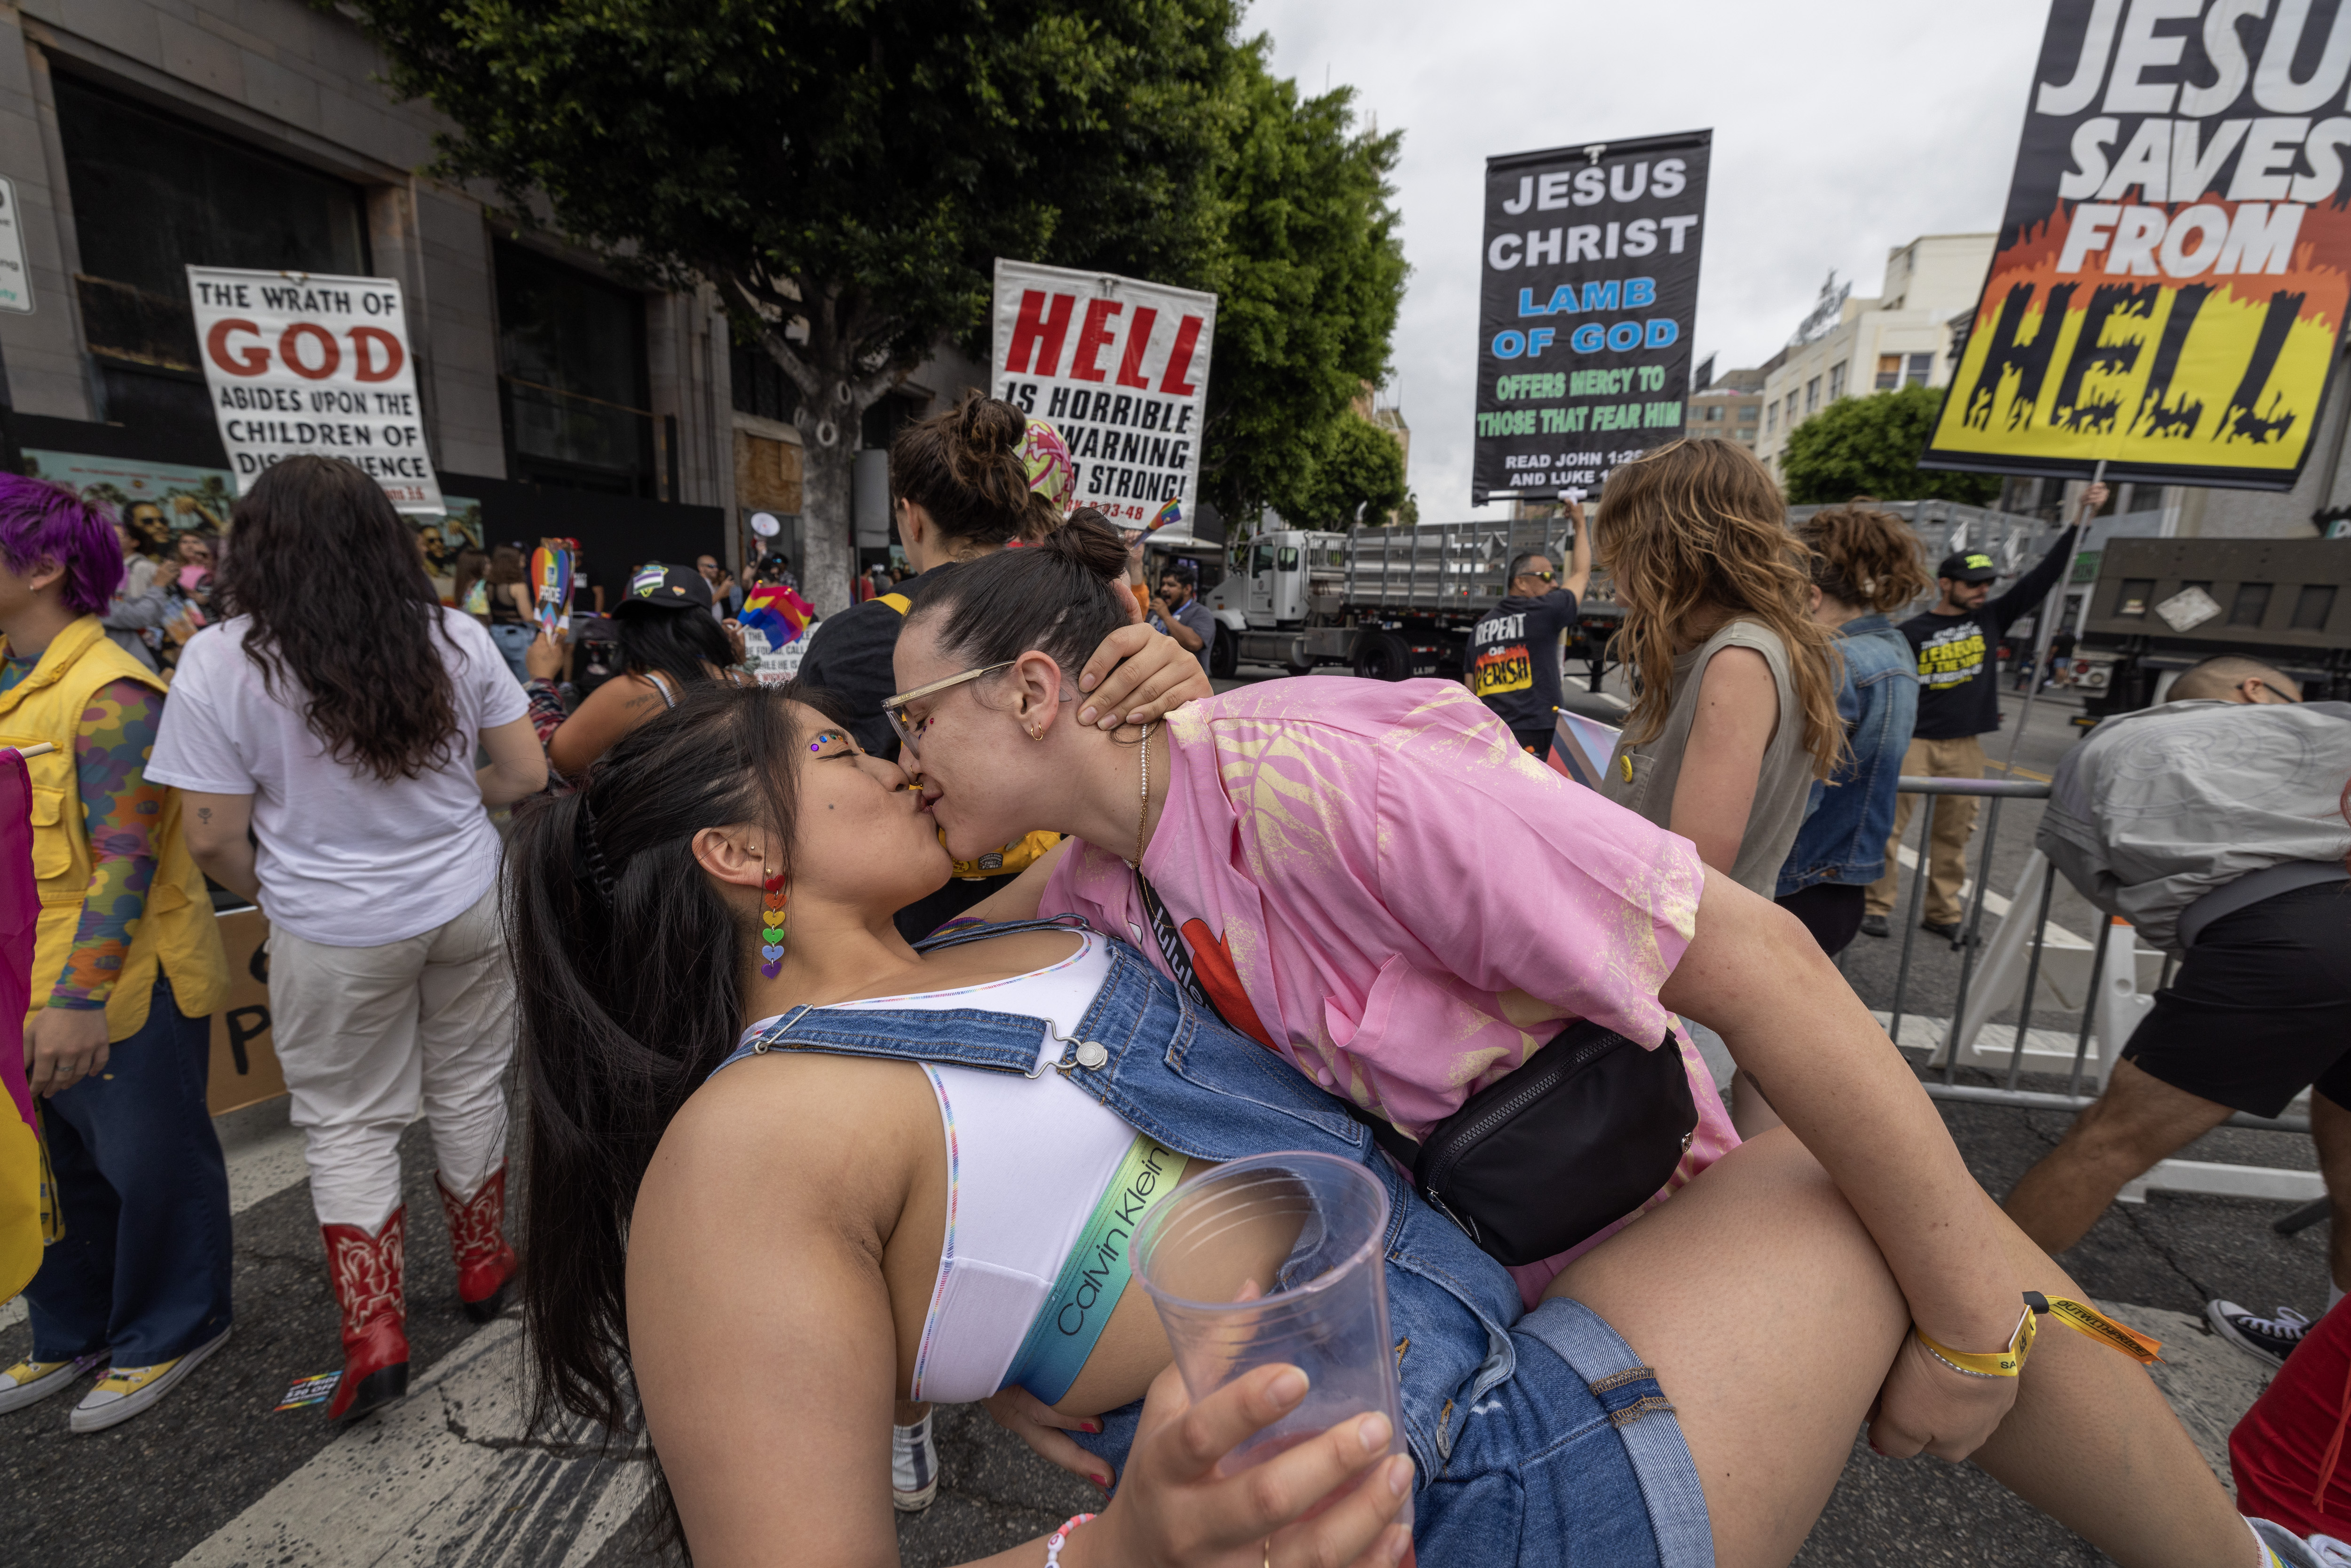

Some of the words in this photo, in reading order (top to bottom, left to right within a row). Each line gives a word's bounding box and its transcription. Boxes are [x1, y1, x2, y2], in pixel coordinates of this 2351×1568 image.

[2036, 0, 2351, 117] JESU
[2058, 117, 2351, 203] SAVES
[1502, 158, 1687, 215] JESUS
[1488, 214, 1699, 270] CHRIST
[2055, 203, 2306, 279] FROM
[197, 283, 251, 308] THE
[261, 286, 352, 314] WRATH
[363, 292, 397, 315] OF
[1518, 276, 1657, 318] LAMB
[207, 318, 404, 384] GOD
[1004, 289, 1204, 396] HELL
[1491, 327, 1556, 360] OF
[1570, 318, 1680, 354] GOD
[1963, 281, 2306, 444] HELL
[220, 386, 302, 412] ABIDES
[311, 390, 369, 415] UPON
[373, 393, 413, 417] THE
[1496, 372, 1566, 401] OFFERS
[1569, 366, 1636, 396] MERCY
[1638, 365, 1665, 392] TO
[1006, 382, 1038, 415] IS
[1048, 386, 1193, 434] HORRIBLE
[1477, 410, 1537, 437] THOSE
[1539, 406, 1589, 434] THAT
[1590, 403, 1642, 432] FEAR
[1644, 401, 1682, 428] HIM
[226, 420, 372, 447] CHILDREN
[383, 425, 418, 447] OF
[1058, 424, 1190, 469] WARNING
[236, 453, 427, 479] DISIENCE
[1506, 454, 1551, 469] READ
[1554, 452, 1602, 467] JOHN
[1509, 473, 1546, 487] AND
[1550, 470, 1595, 485] LUKE
[1088, 464, 1187, 503] STRONG!
[539, 584, 561, 604] PRIDE
[1475, 613, 1526, 647] REPENT
[786, 646, 804, 654] CALL
[1488, 646, 1506, 656] OR
[1477, 656, 1528, 690] PERISH
[898, 692, 916, 701] GUCCI
[1057, 1228, 1128, 1336] Calvin
[1115, 1146, 1169, 1227] Klein
